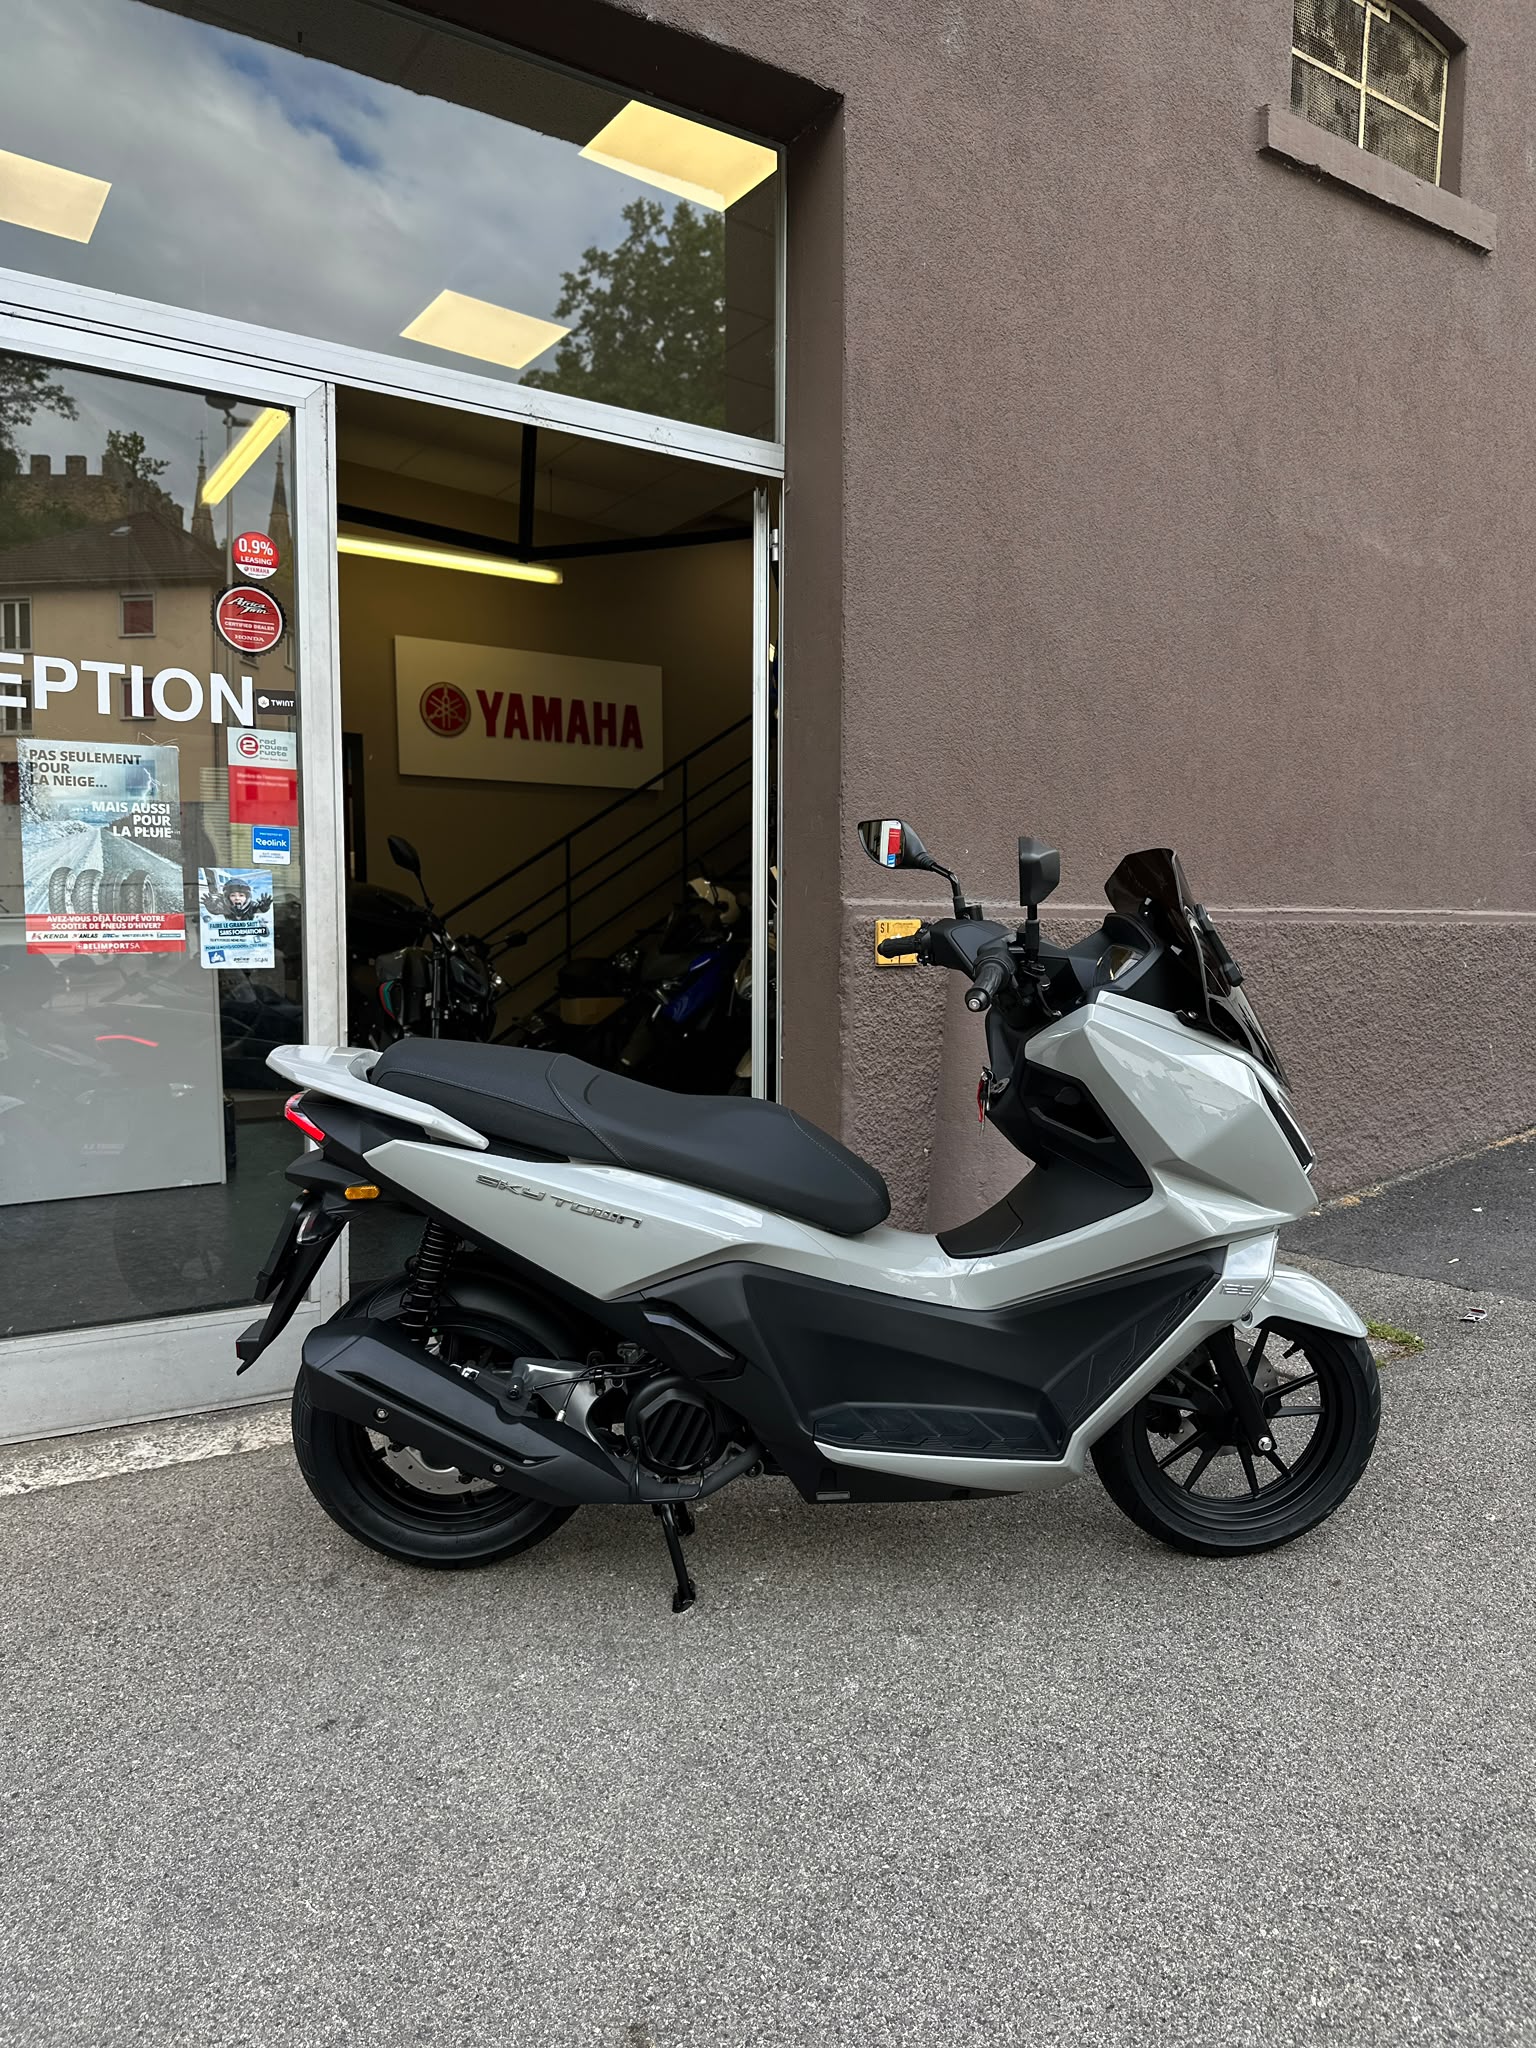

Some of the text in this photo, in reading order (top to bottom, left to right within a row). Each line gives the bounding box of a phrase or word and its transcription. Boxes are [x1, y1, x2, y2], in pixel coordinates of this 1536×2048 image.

[238, 537, 274, 556] 0.9%
[226, 596, 266, 608] Africa
[224, 621, 275, 631] CERTIFIED DEALER
[234, 634, 265, 642] HONDA
[270, 698, 295, 708] TWINT
[475, 689, 644, 749] YAMAHA
[259, 744, 288, 752] roues
[29, 749, 142, 766] PAS SEULEMENT
[29, 762, 71, 774] POUR
[30, 774, 49, 786] LA
[131, 801, 170, 814] AUSSI
[133, 815, 171, 826] POUR
[112, 825, 172, 838] LA PLUIE
[255, 837, 287, 848] Reolink
[46, 915, 91, 923] AVEZ-VOUS
[92, 914, 112, 924] DÉJÀ
[112, 914, 140, 924] ÉQUIPÉ
[475, 1174, 643, 1229] SKY TOWN
